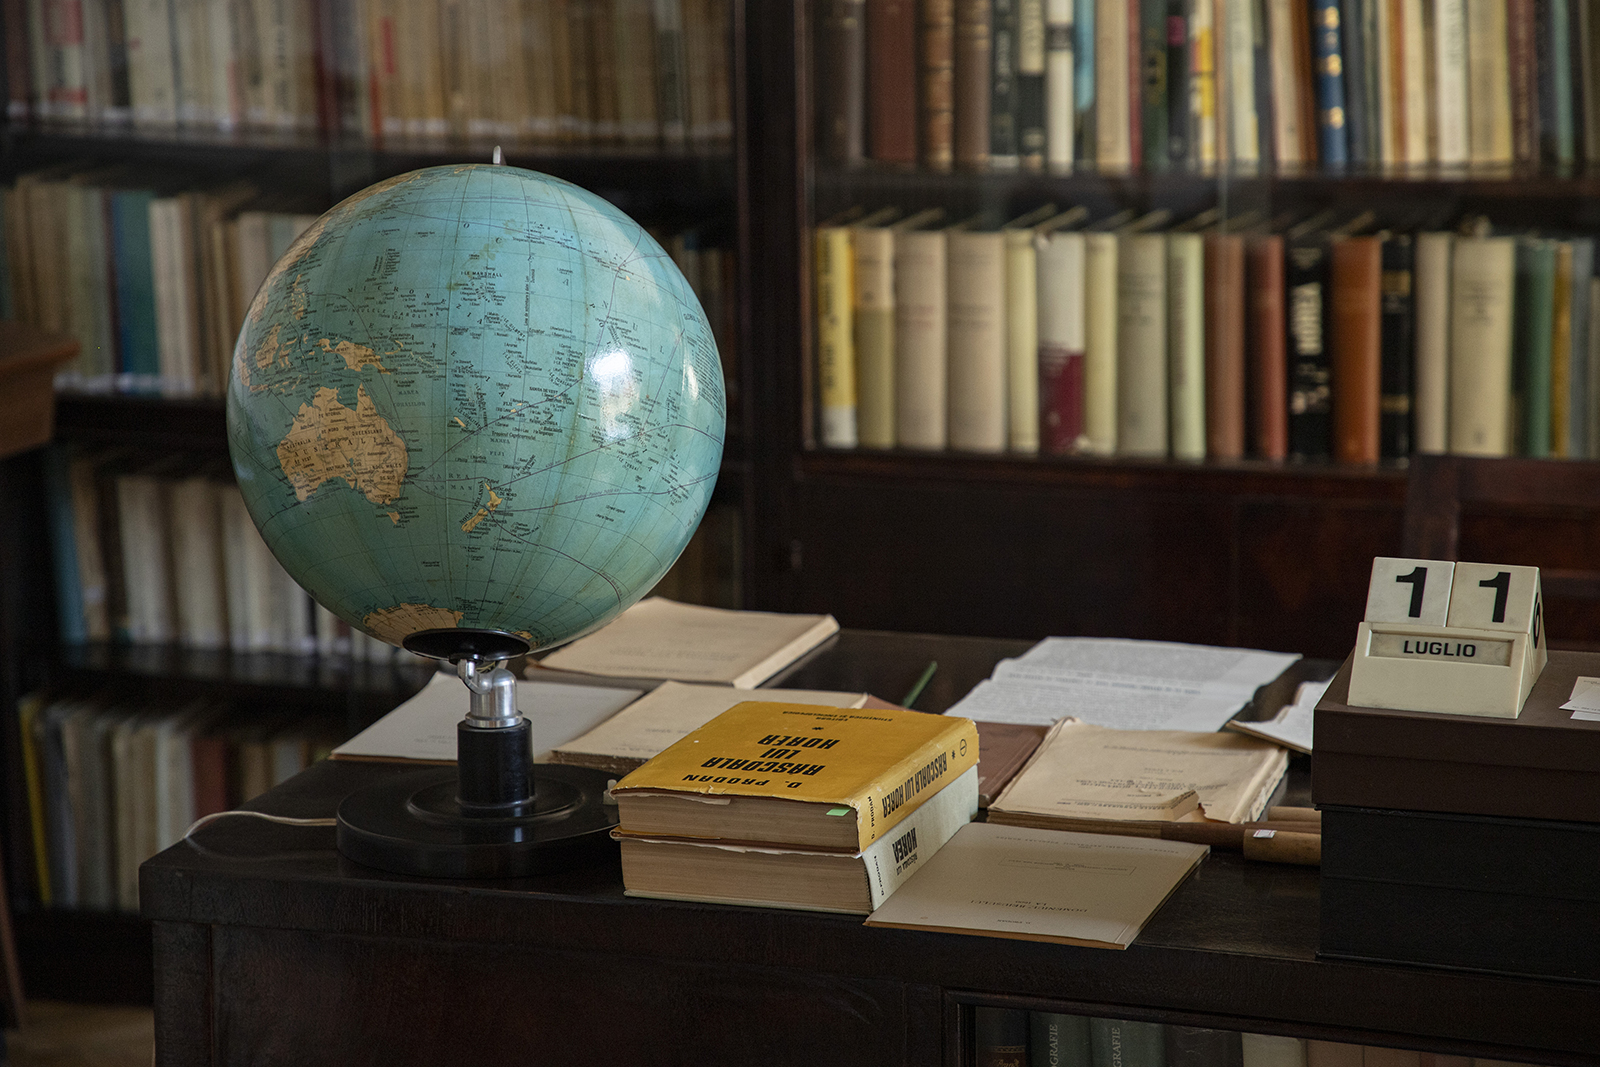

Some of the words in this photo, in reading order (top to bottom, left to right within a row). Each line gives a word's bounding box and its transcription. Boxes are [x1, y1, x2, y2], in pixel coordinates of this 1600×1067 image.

[351, 428, 383, 436] QUEENSLAND
[1402, 640, 1477, 658] LUGLIO
[756, 734, 841, 750] HOREA
[759, 748, 802, 760] LUI
[681, 774, 770, 787] PRODAN
[784, 780, 803, 789] D.
[904, 776, 915, 802] LUI
[881, 784, 905, 819] HOREA
[891, 826, 918, 864] HOREA
